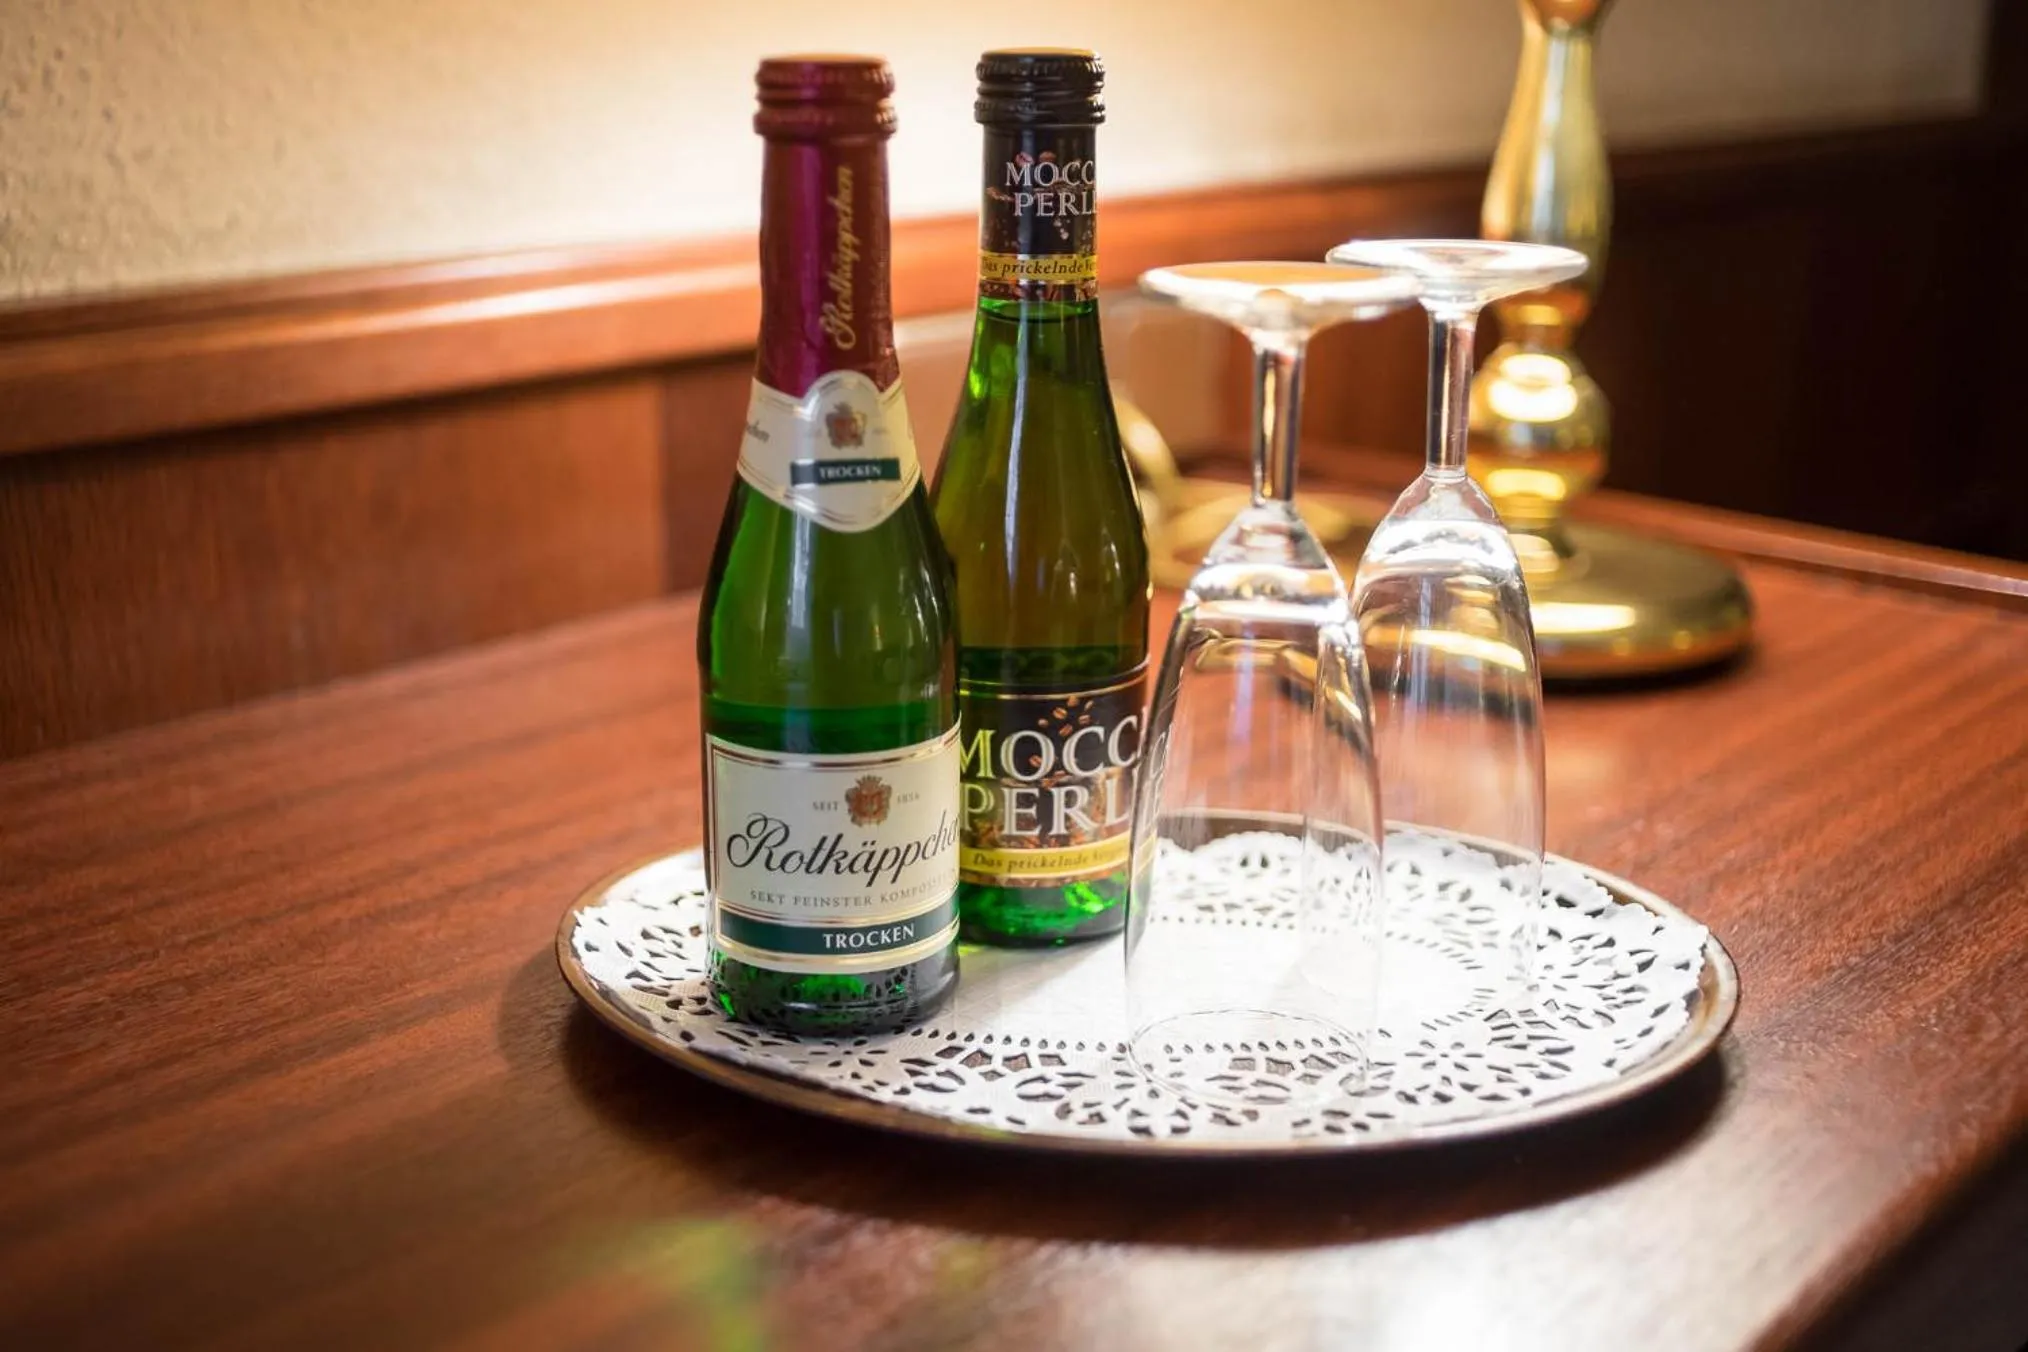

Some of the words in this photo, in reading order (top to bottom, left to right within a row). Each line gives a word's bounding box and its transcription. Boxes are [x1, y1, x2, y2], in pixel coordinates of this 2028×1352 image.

[1001, 259, 1082, 277] prickelnde
[819, 464, 883, 480] TROCKEN
[812, 800, 839, 812] SEIT
[973, 852, 1003, 868] Das
[1007, 852, 1088, 873] prickelnde
[750, 889, 786, 905] SEKT
[793, 895, 873, 908] FEINSTER
[823, 922, 916, 949] TROCKEN
